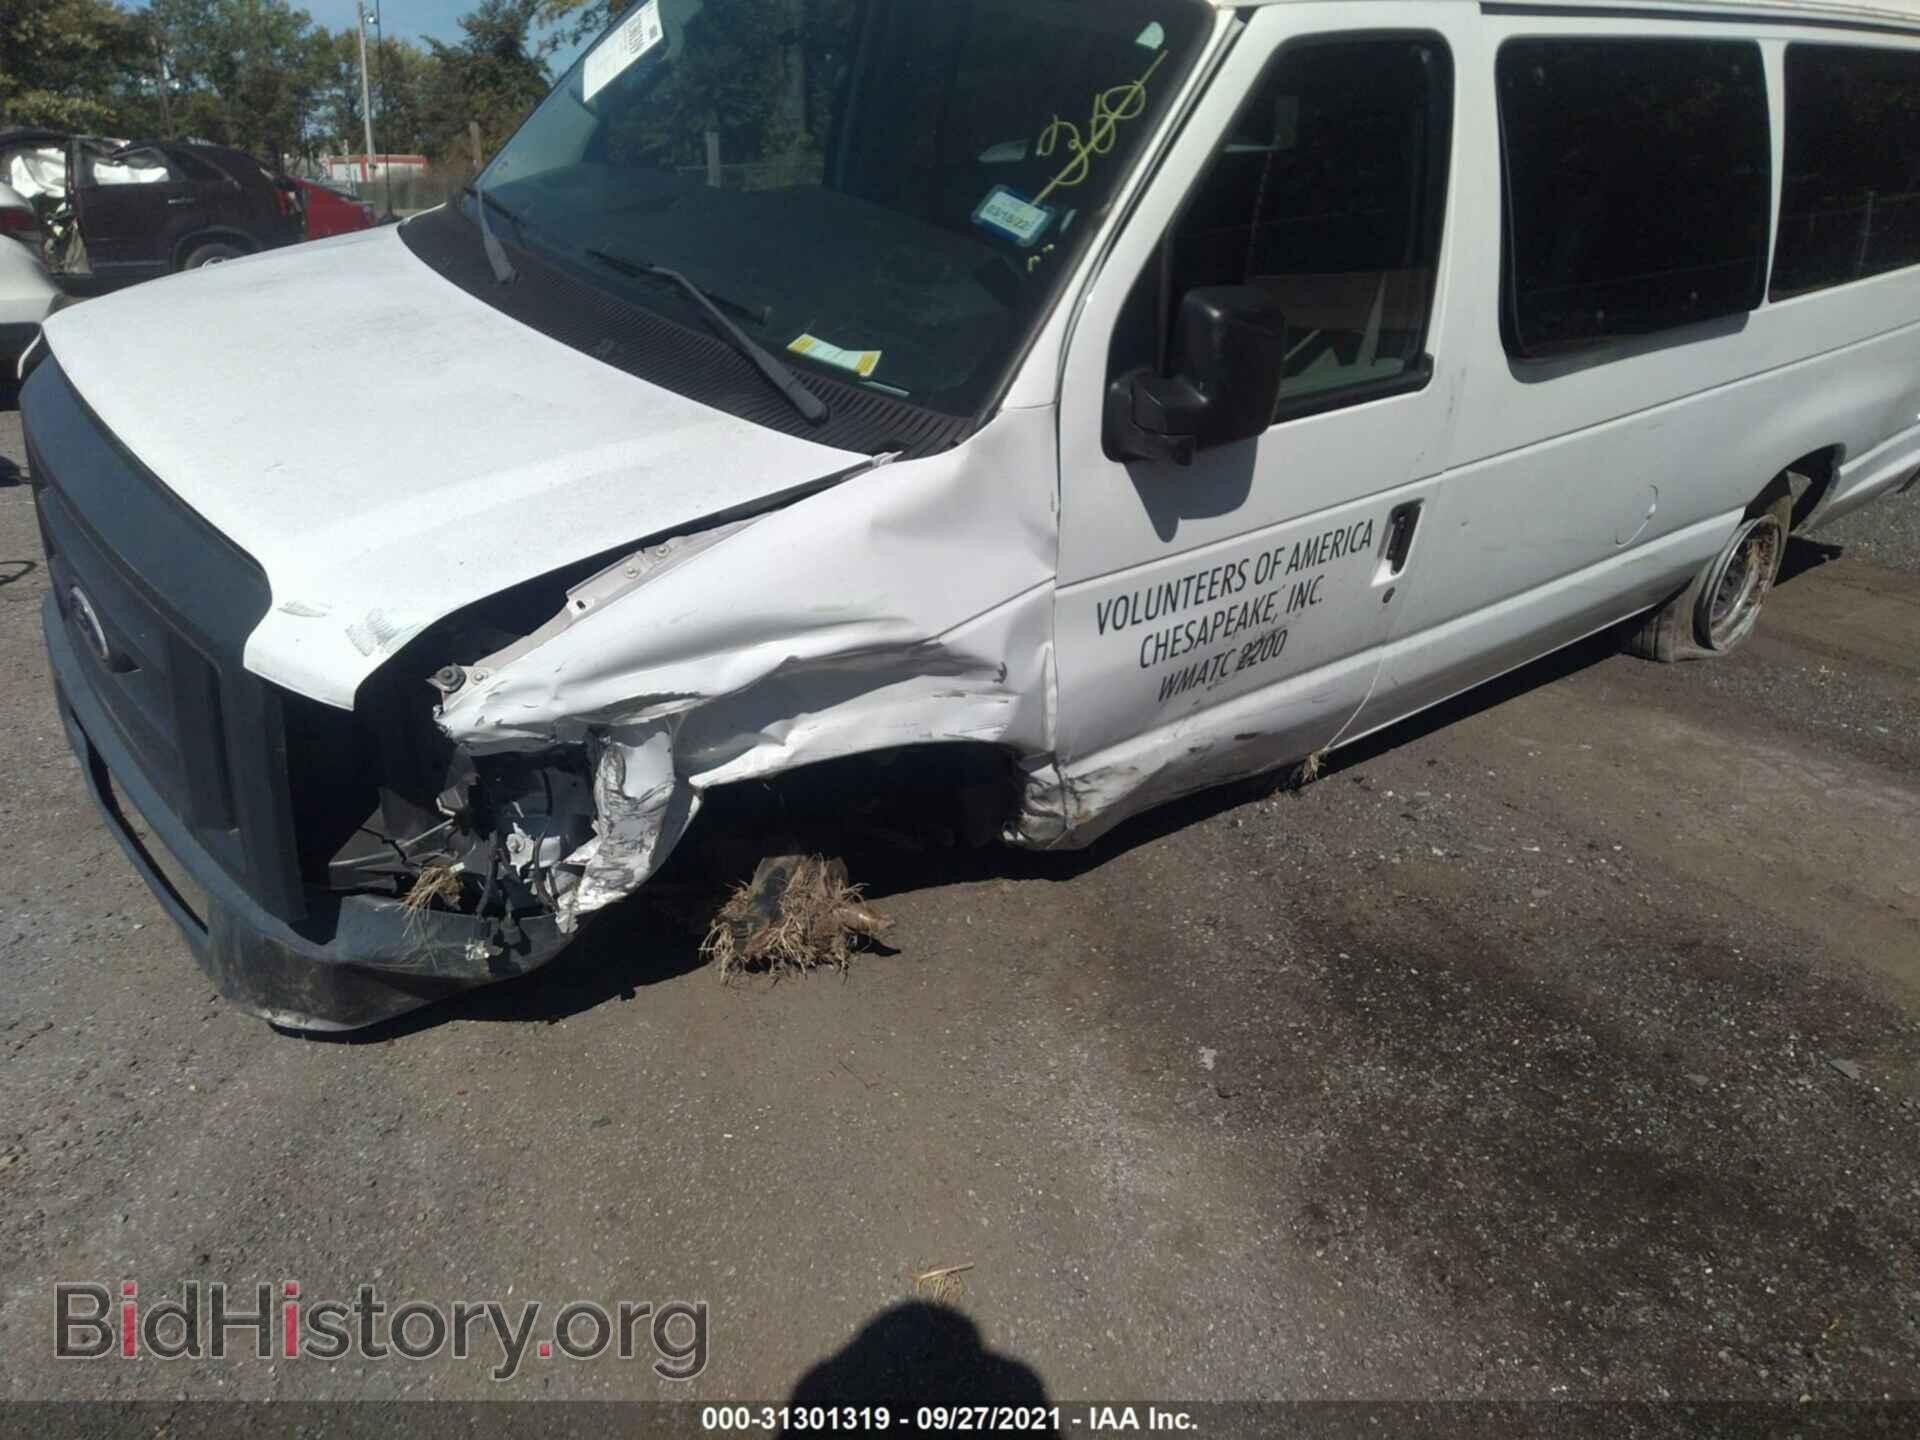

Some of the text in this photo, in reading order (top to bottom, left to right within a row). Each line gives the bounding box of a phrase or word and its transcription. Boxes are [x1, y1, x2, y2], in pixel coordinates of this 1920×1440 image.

[1096, 518, 1375, 636] VOLUNTEERS OF AMERICA
[1285, 574, 1326, 615] INC.
[1157, 648, 1237, 703] WMATC
